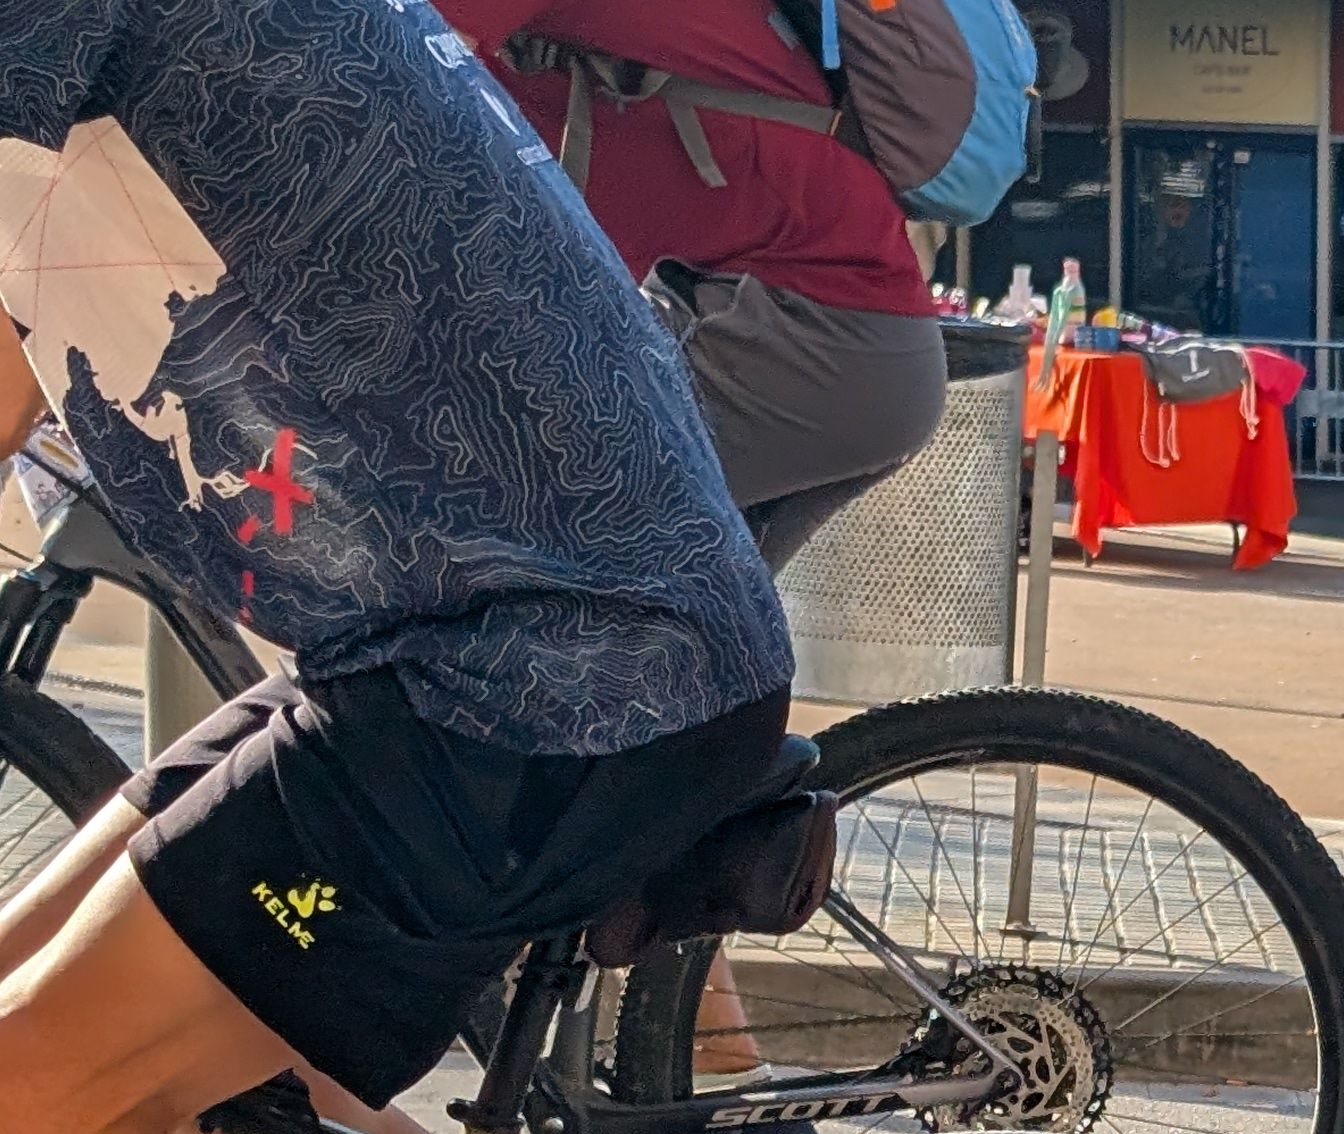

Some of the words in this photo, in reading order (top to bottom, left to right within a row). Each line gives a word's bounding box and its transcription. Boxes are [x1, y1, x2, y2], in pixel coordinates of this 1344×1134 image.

[1169, 24, 1280, 56] MANEL
[251, 882, 316, 950] KELME
[705, 1092, 899, 1129] SCOTT
